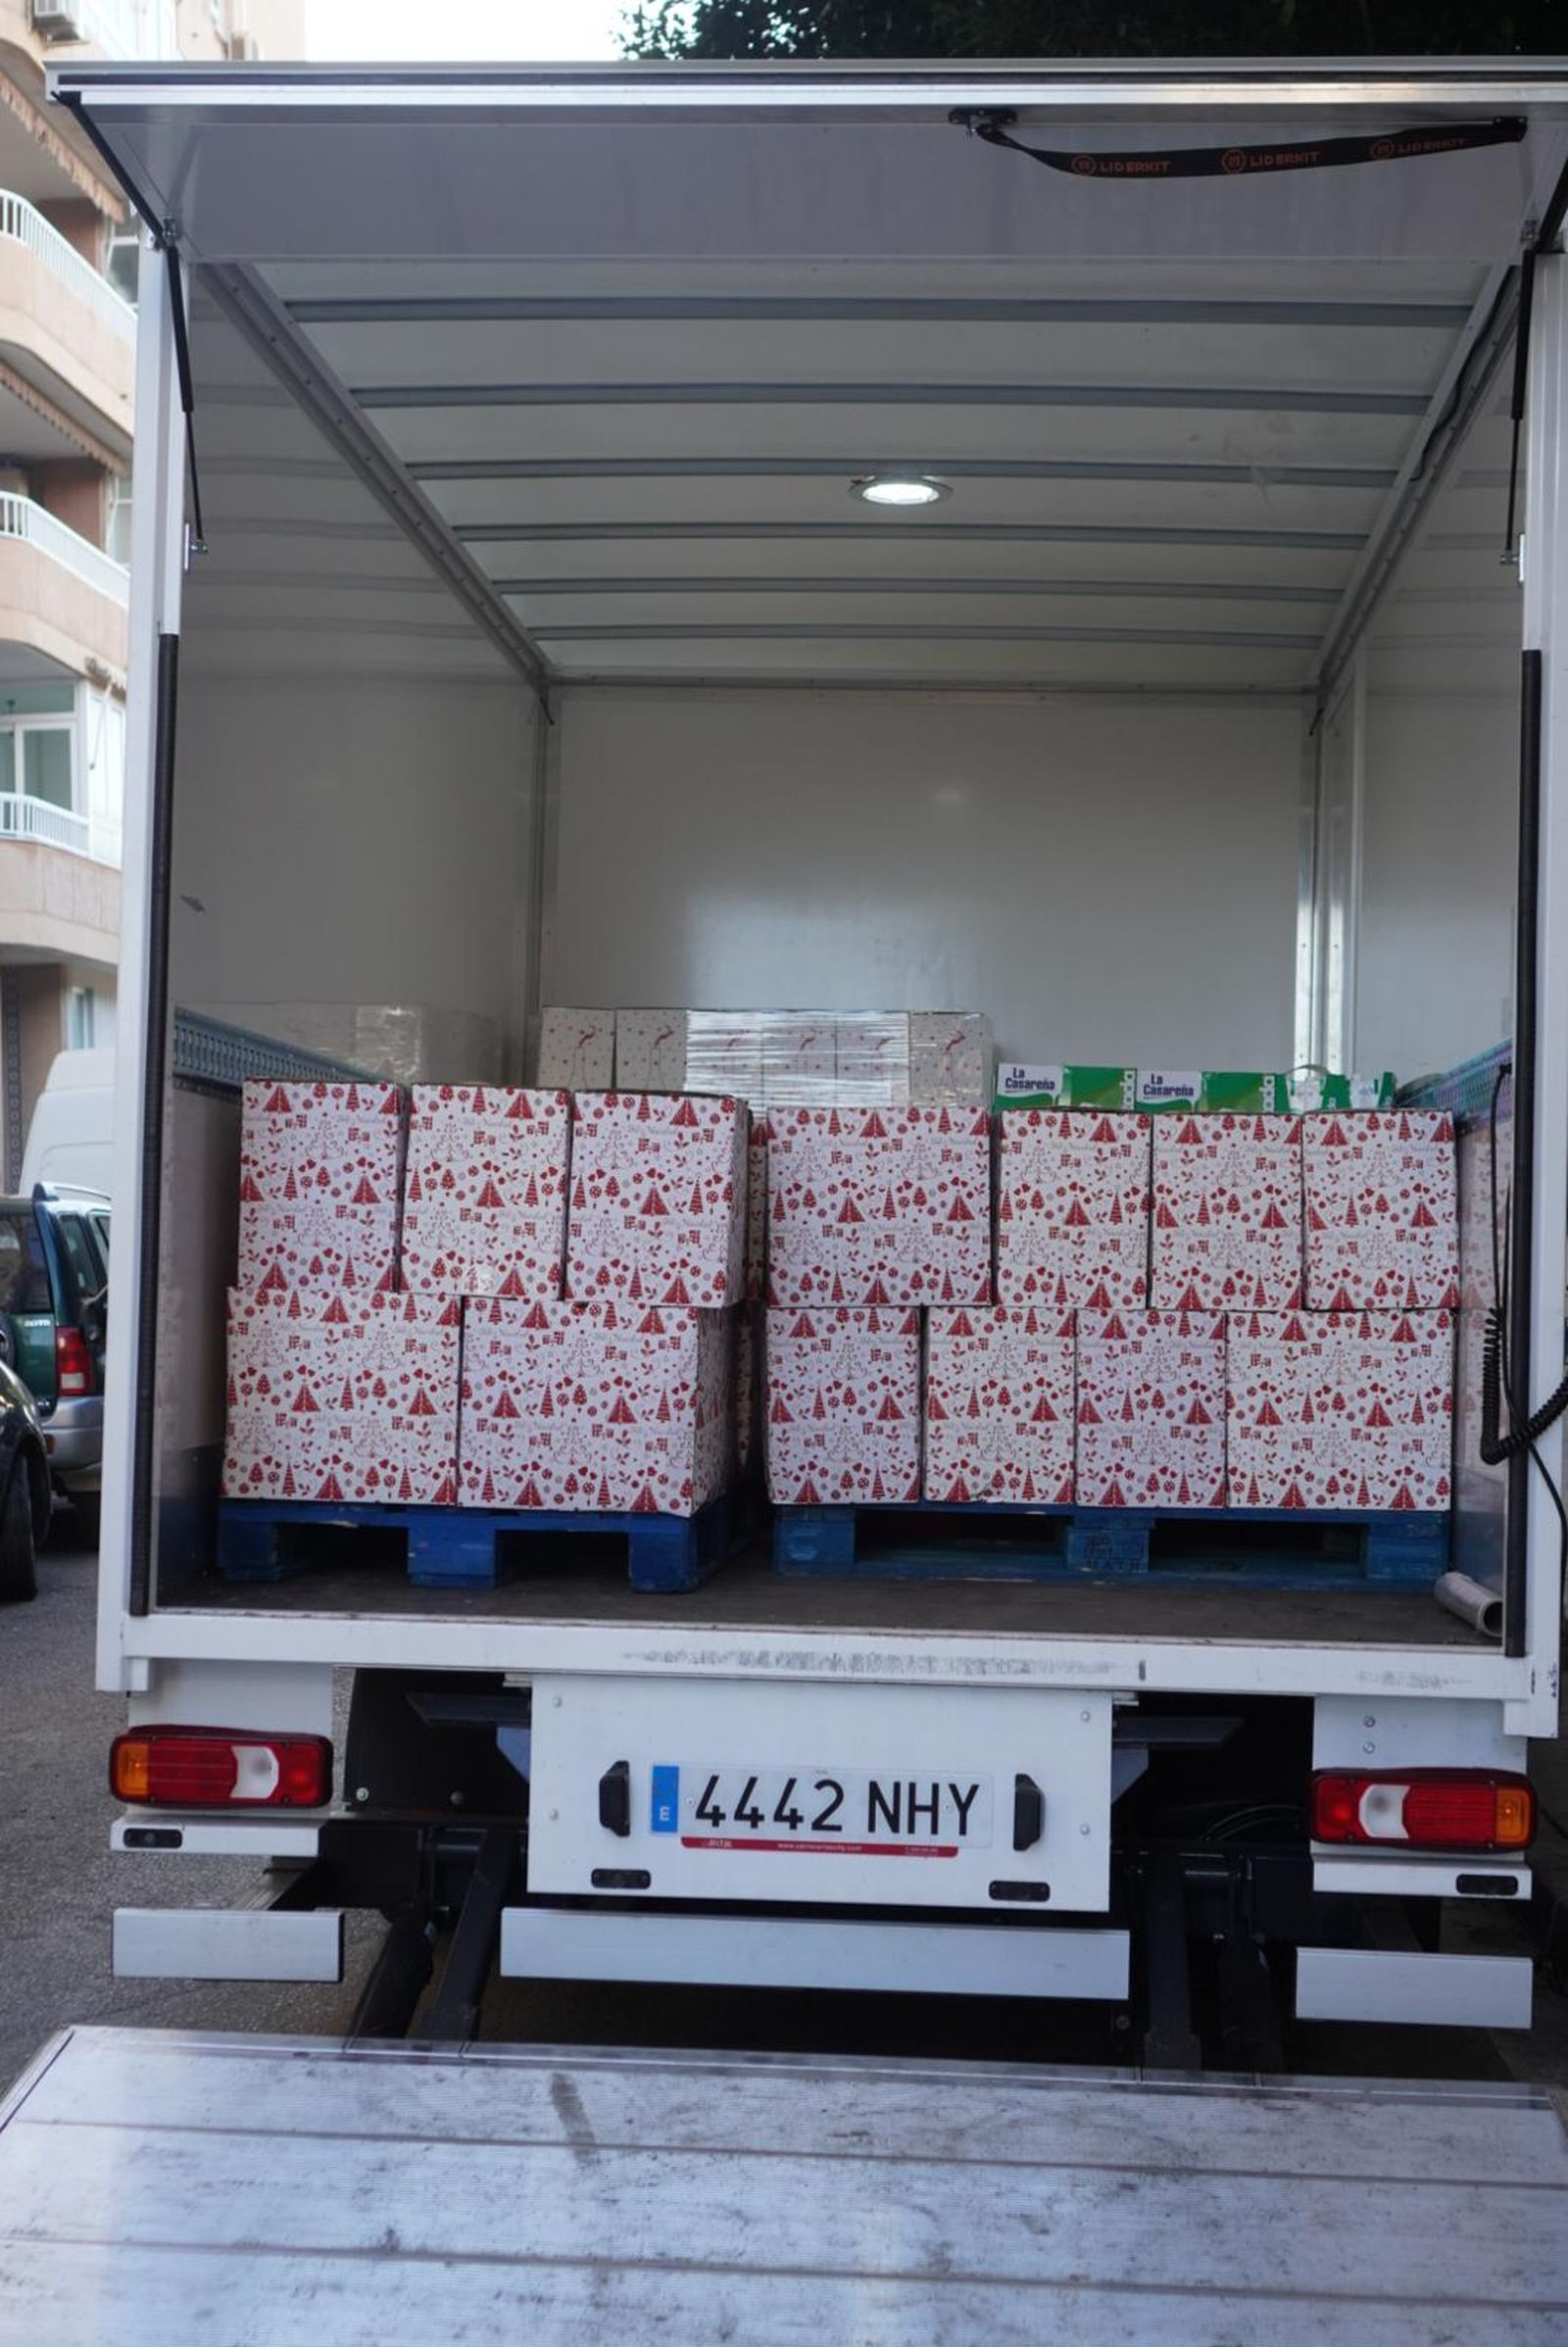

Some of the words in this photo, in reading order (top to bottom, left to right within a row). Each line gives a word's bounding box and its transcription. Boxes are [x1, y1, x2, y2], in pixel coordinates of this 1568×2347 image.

[1250, 151, 1321, 167] LIDERKIT
[1099, 160, 1172, 173] LIDERKIT
[1012, 1067, 1025, 1079] La
[1151, 1073, 1163, 1085] La
[1004, 1077, 1055, 1091] Casareña
[1143, 1083, 1195, 1097] Casareña
[695, 1775, 845, 1833] 4442
[867, 1780, 980, 1836] NHY
[660, 1806, 670, 1822] E
